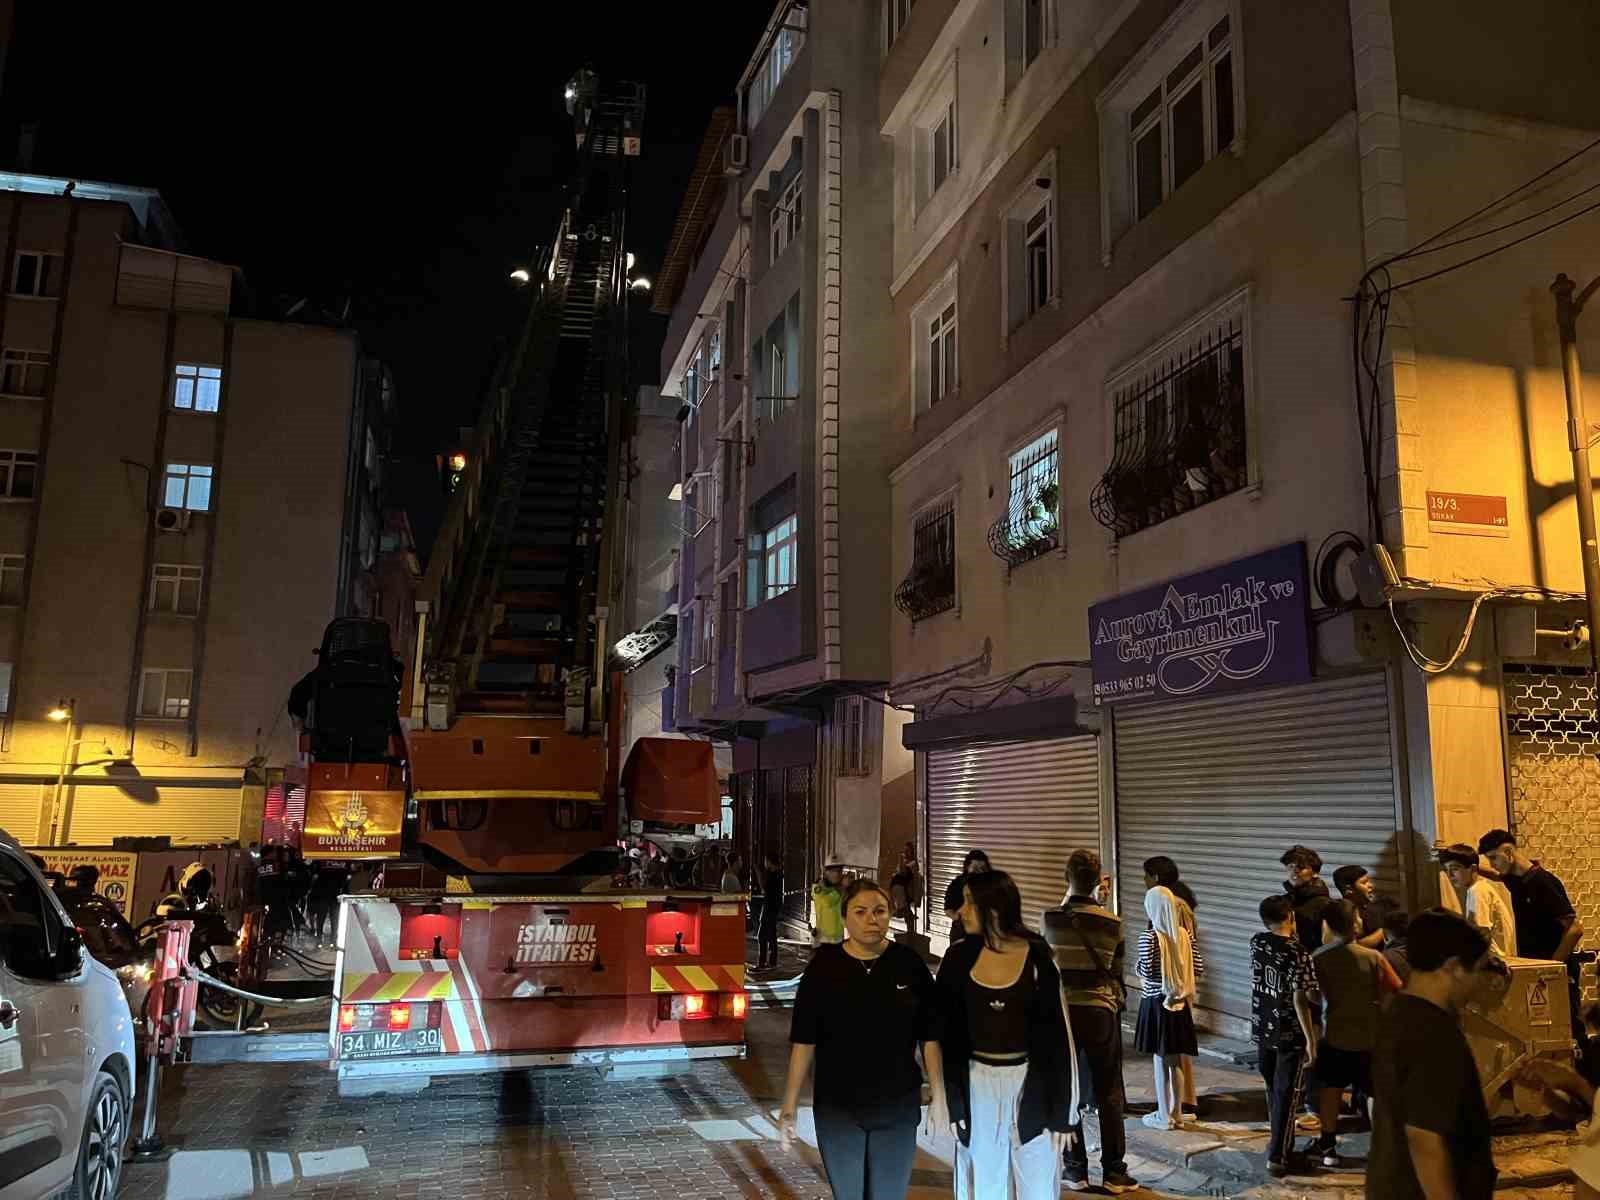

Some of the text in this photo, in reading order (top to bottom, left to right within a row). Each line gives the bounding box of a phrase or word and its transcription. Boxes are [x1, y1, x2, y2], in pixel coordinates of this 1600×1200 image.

[1095, 576, 1295, 646] Aurova Emlak ve
[1118, 605, 1263, 664] Gayrimenkul
[343, 1029, 438, 1052] 34 MIZ 30
